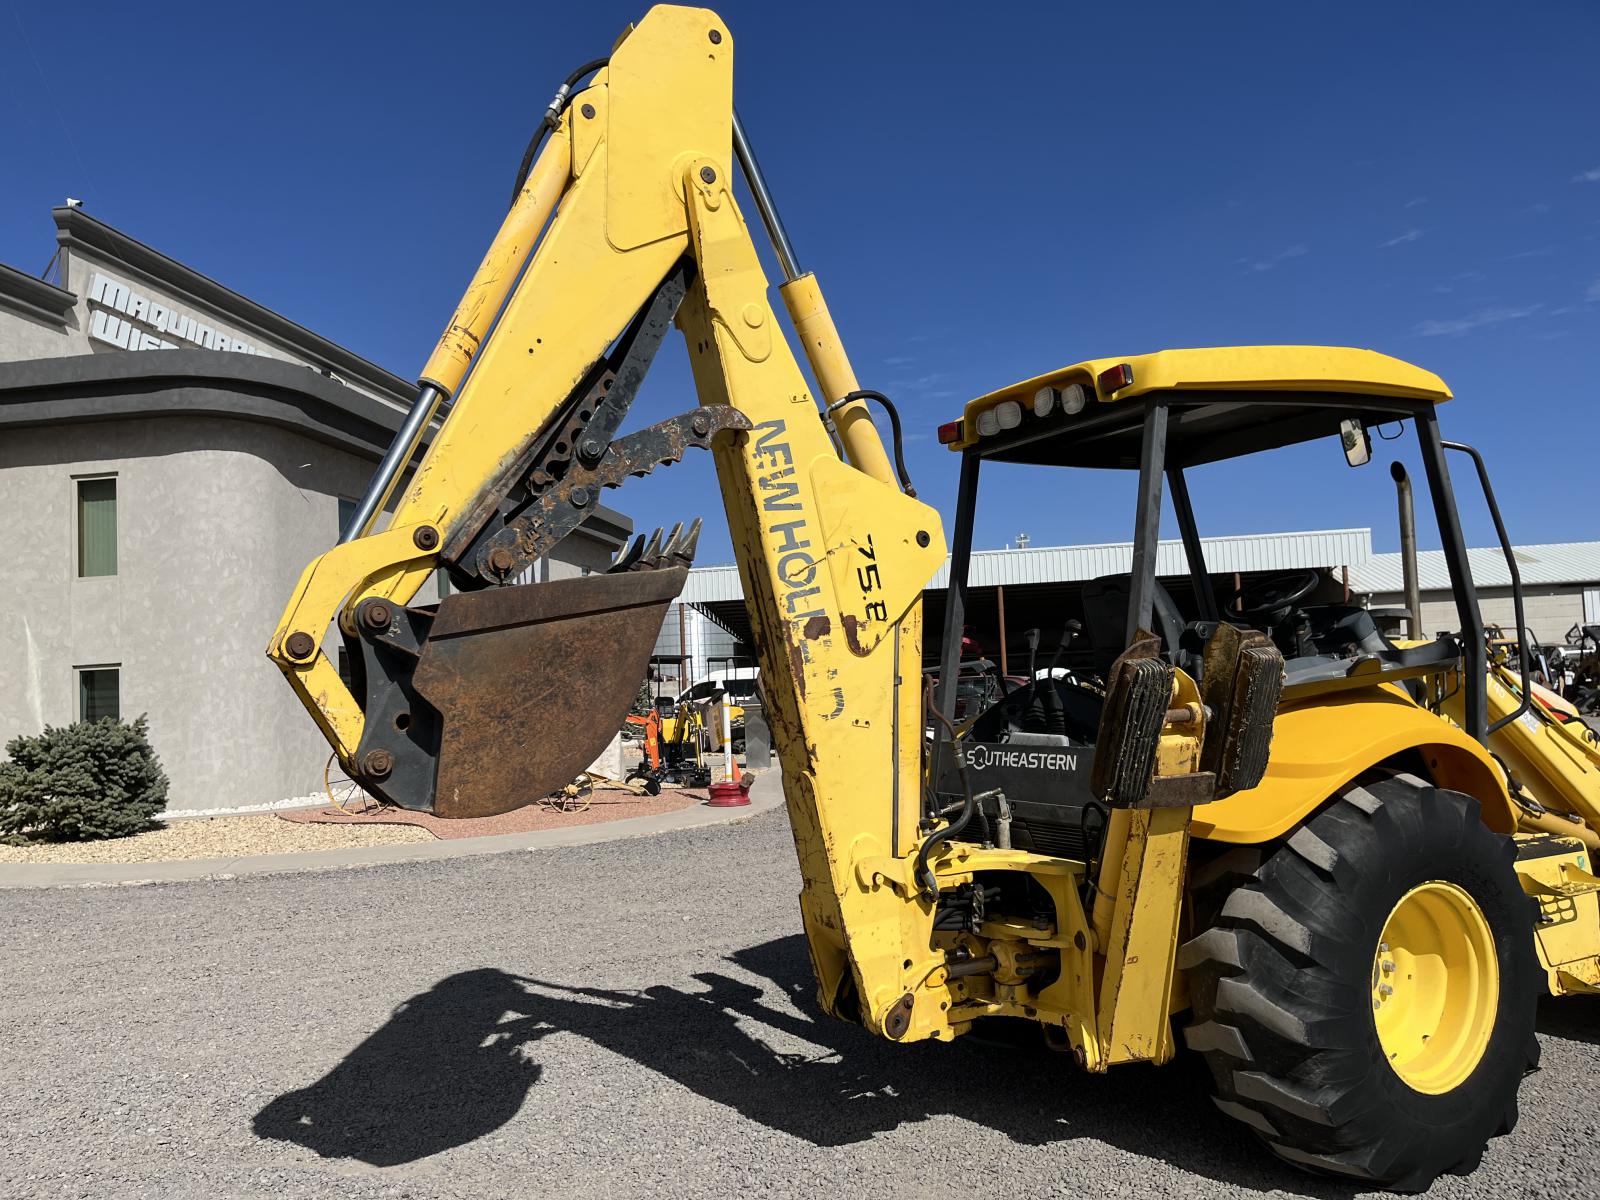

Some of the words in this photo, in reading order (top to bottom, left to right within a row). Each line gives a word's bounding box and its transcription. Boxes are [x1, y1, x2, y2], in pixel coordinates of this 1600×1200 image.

[90, 273, 272, 357] MAQUINAR
[752, 419, 803, 511] NEW
[769, 519, 846, 721] HOLL
[966, 745, 1077, 771] SOUTHEASTERN
